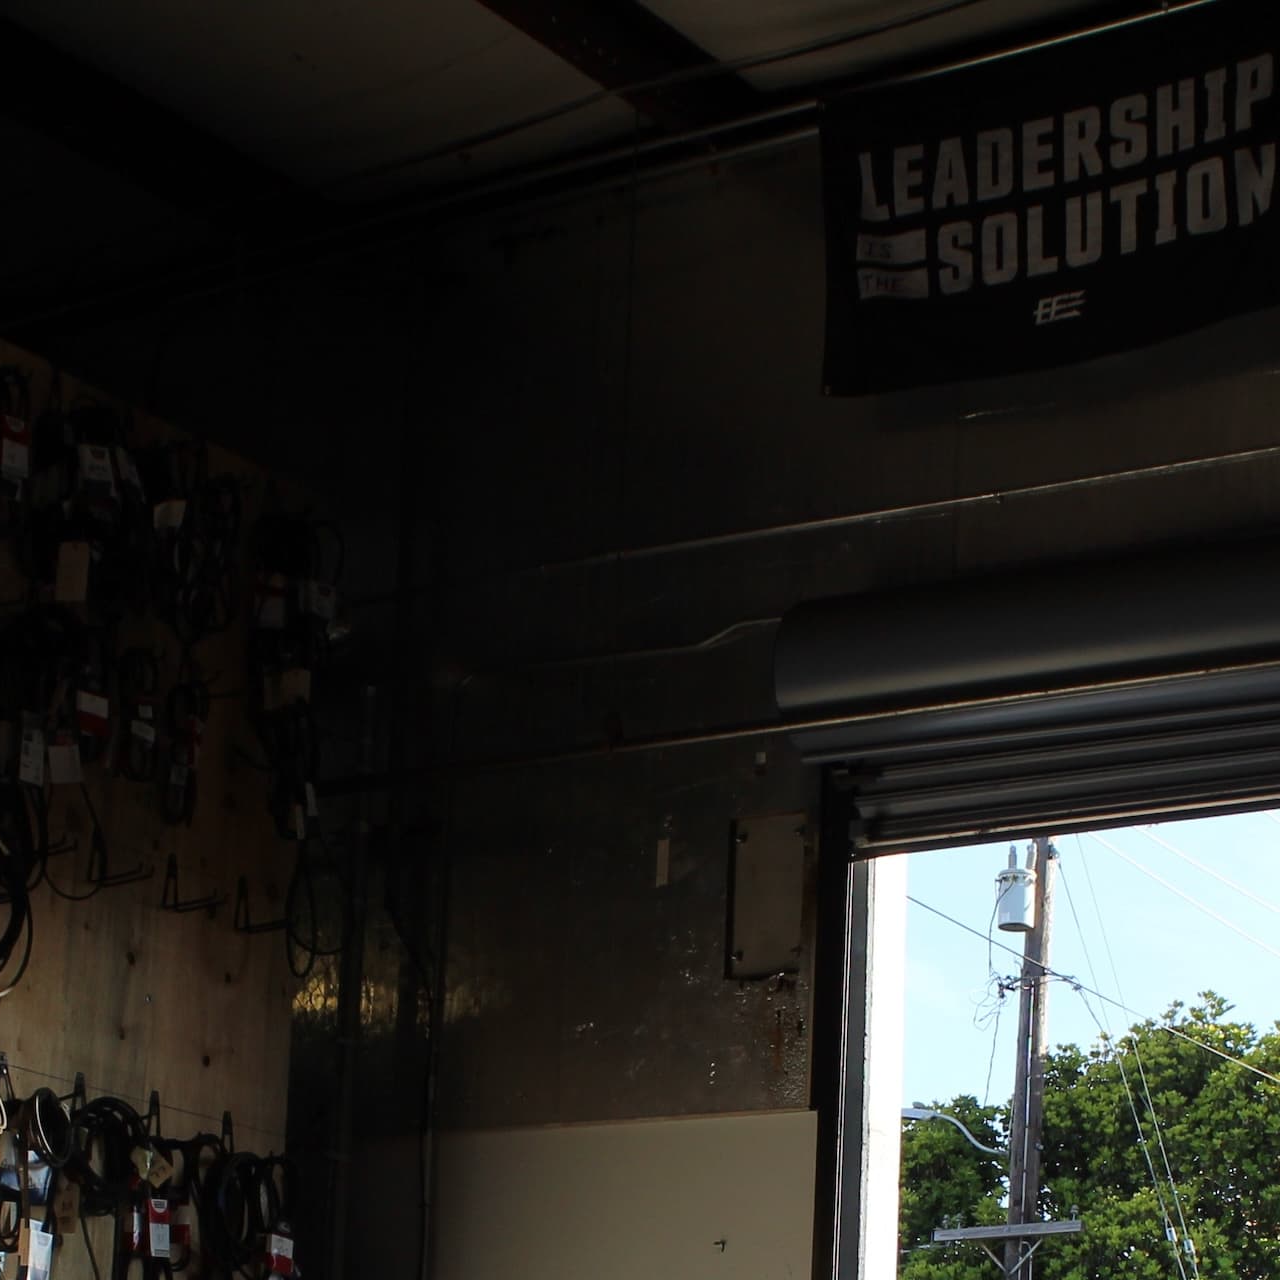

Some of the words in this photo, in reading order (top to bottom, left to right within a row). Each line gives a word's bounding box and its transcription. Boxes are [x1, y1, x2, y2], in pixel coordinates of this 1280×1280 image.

[857, 51, 1275, 223] LEADERSHIP
[863, 239, 892, 259] IS
[936, 142, 1278, 296] SOLUTION
[862, 272, 904, 293] THE
